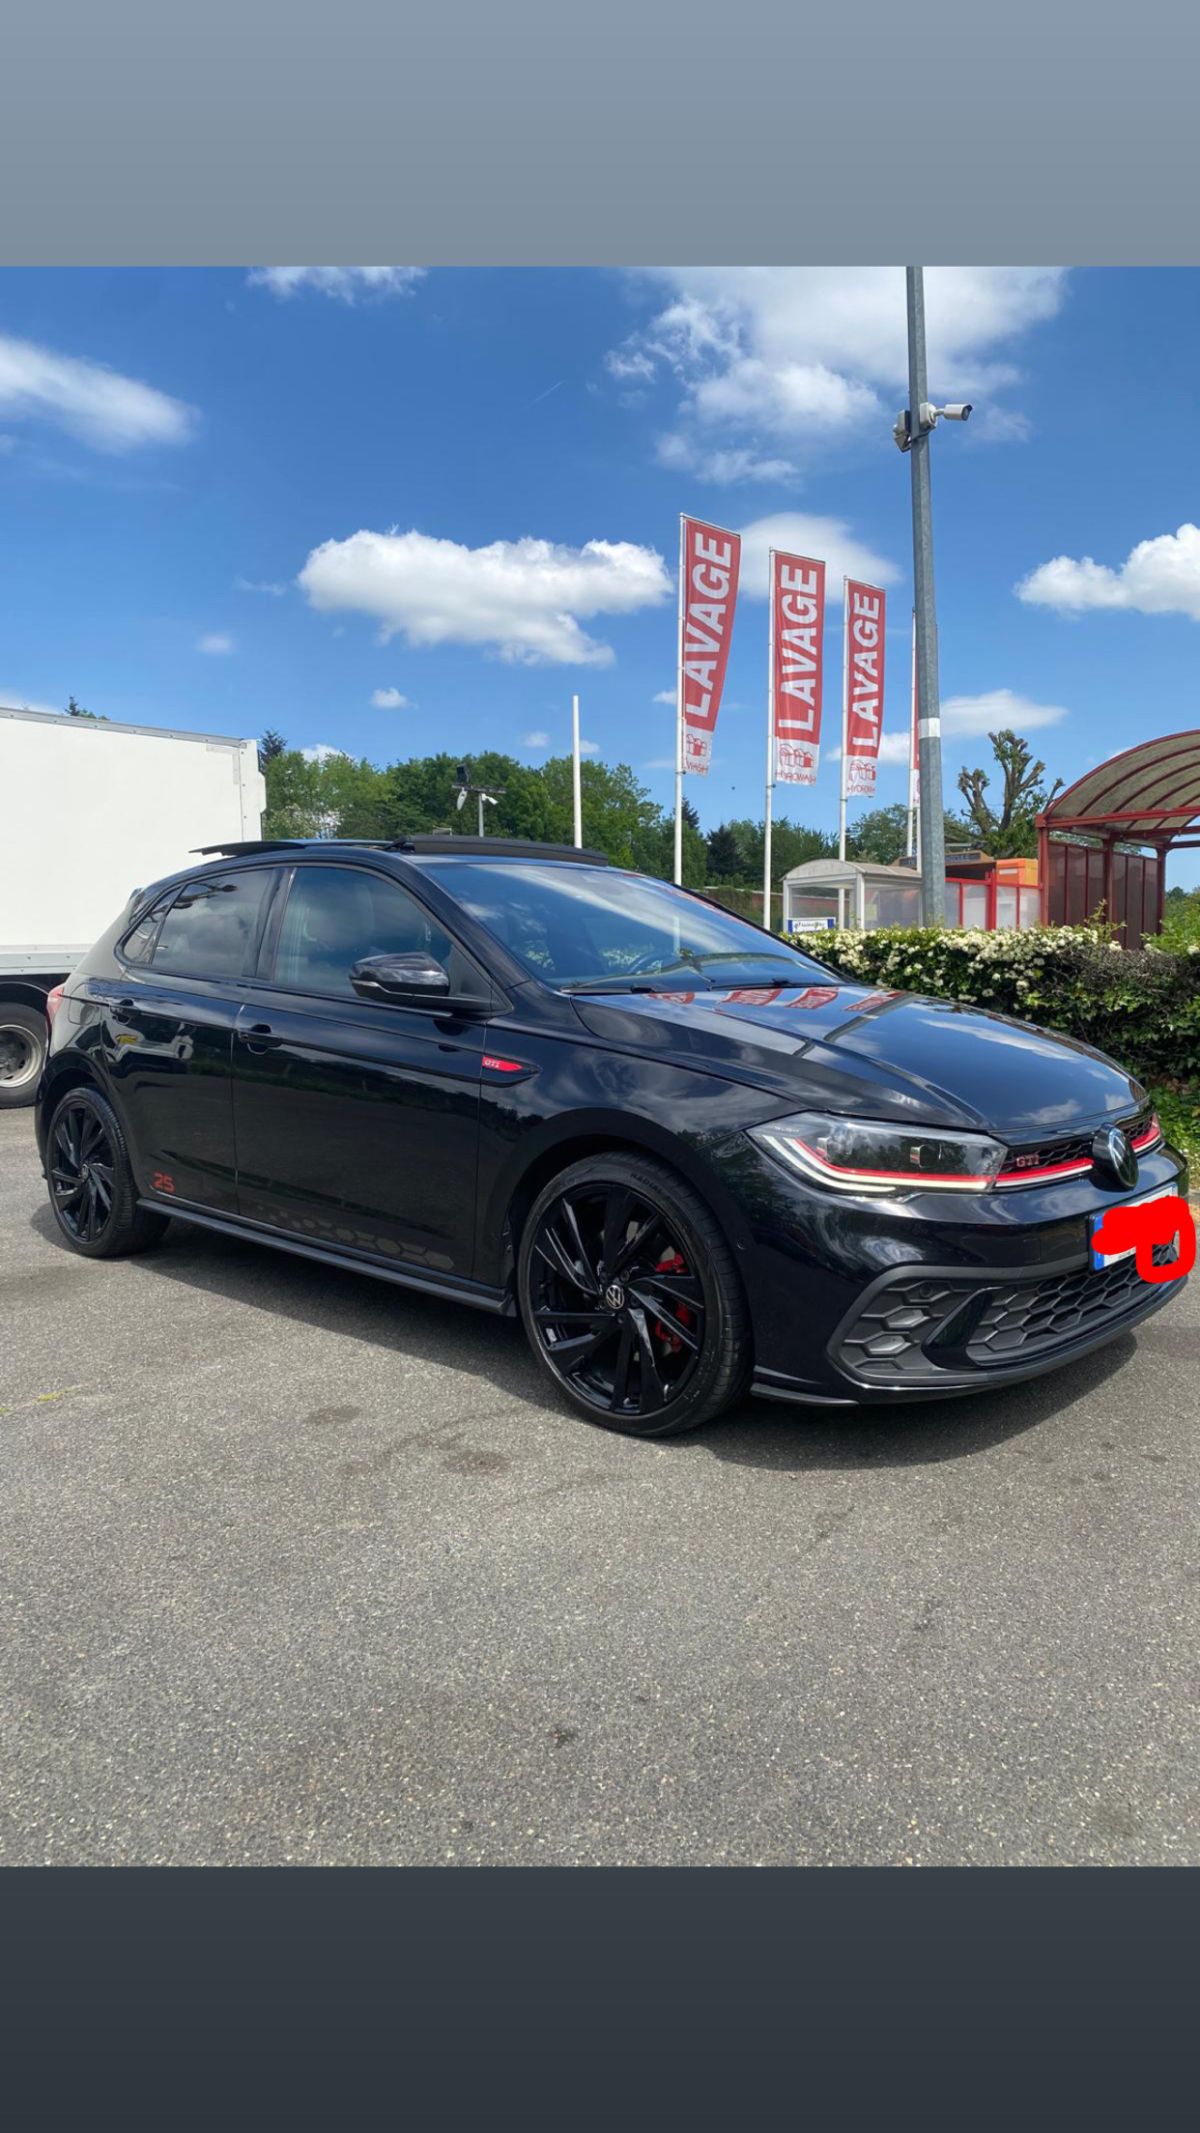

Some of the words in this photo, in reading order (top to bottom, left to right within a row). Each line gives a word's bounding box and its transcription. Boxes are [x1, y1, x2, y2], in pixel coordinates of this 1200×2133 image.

[684, 533, 732, 719] LAVAGE
[778, 565, 817, 732] LAVAGE
[852, 592, 880, 748] LAVAGE
[152, 1170, 176, 1194] 25
[1016, 1154, 1040, 1168] GTI
